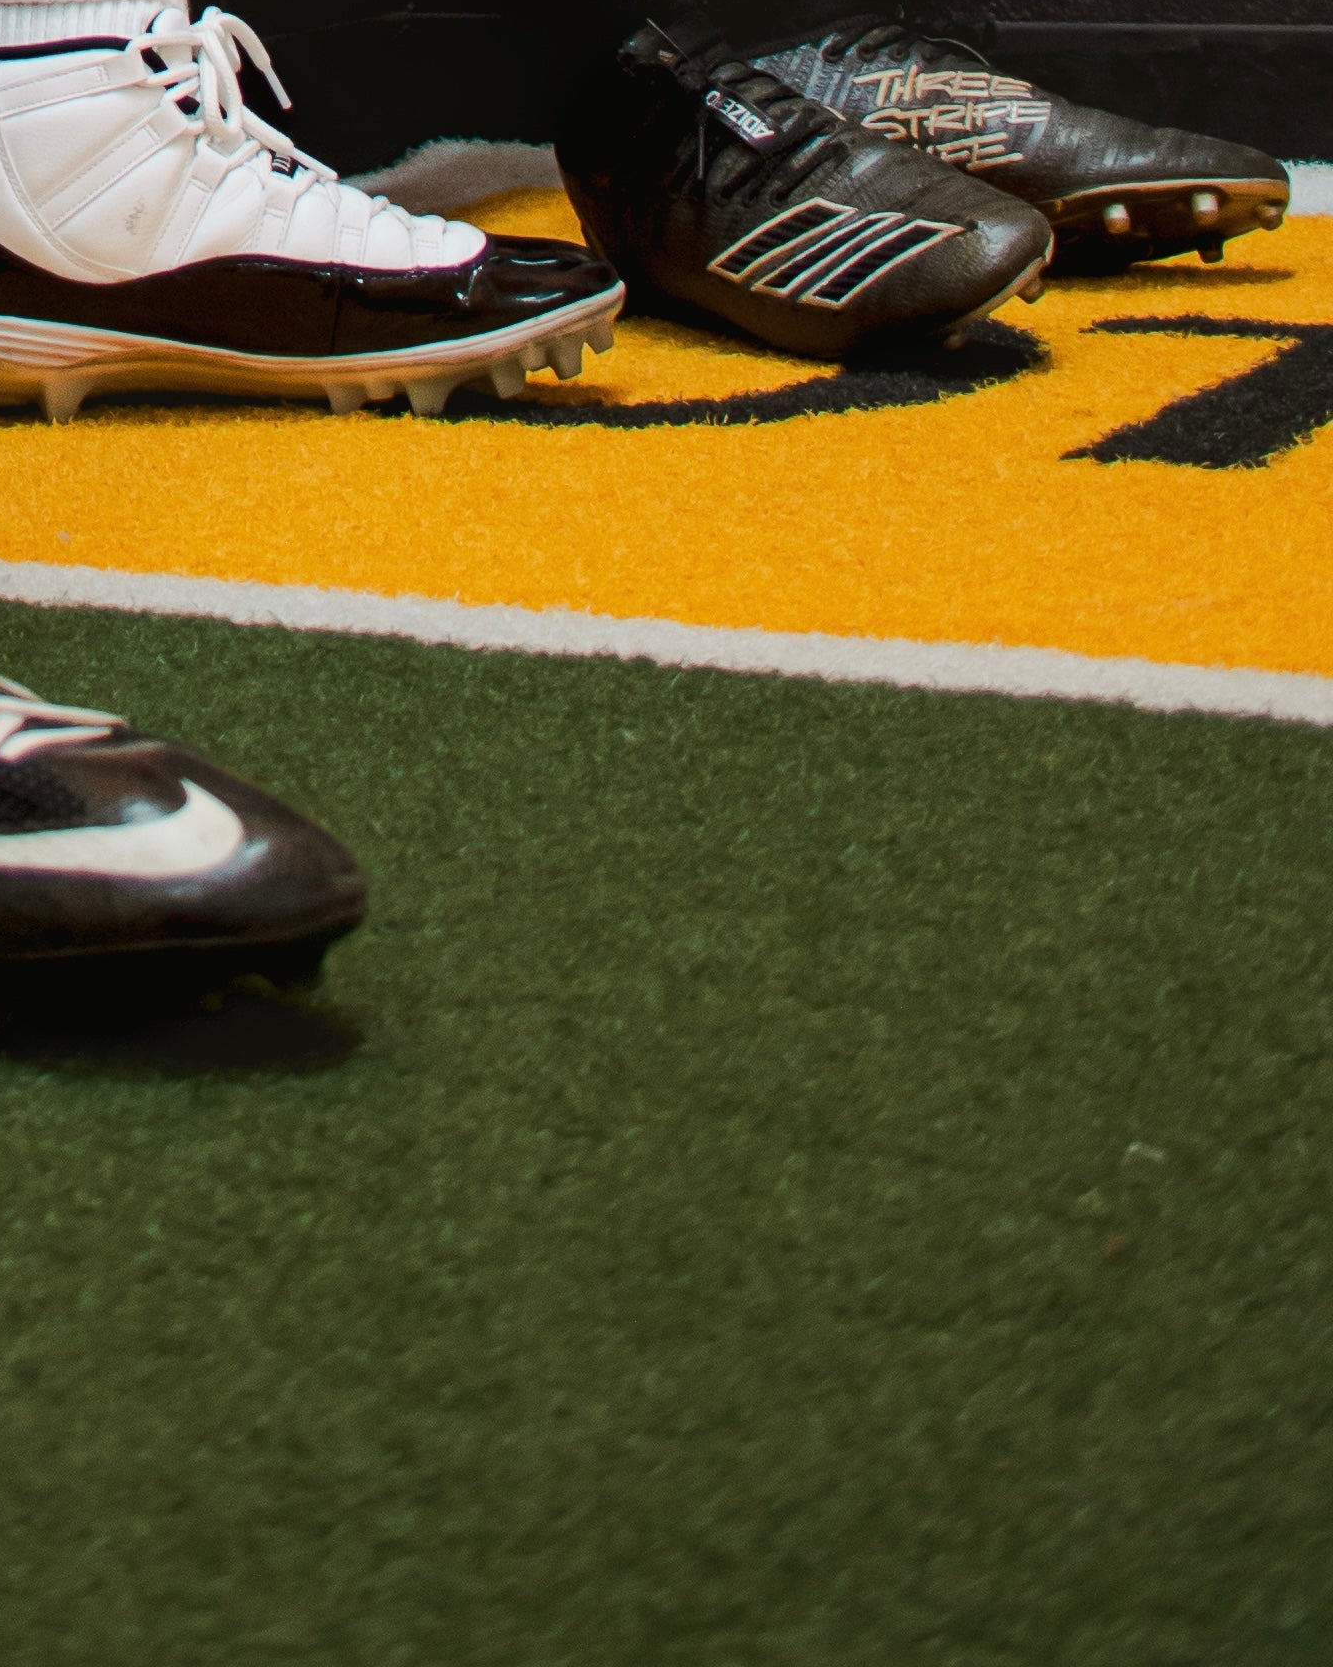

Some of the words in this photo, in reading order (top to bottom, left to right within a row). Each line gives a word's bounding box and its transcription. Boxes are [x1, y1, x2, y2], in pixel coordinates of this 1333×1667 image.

[853, 64, 1033, 107] THREE
[704, 90, 776, 140] ADIZEO
[860, 101, 1052, 141] STRIPE
[914, 132, 1024, 170] FE
